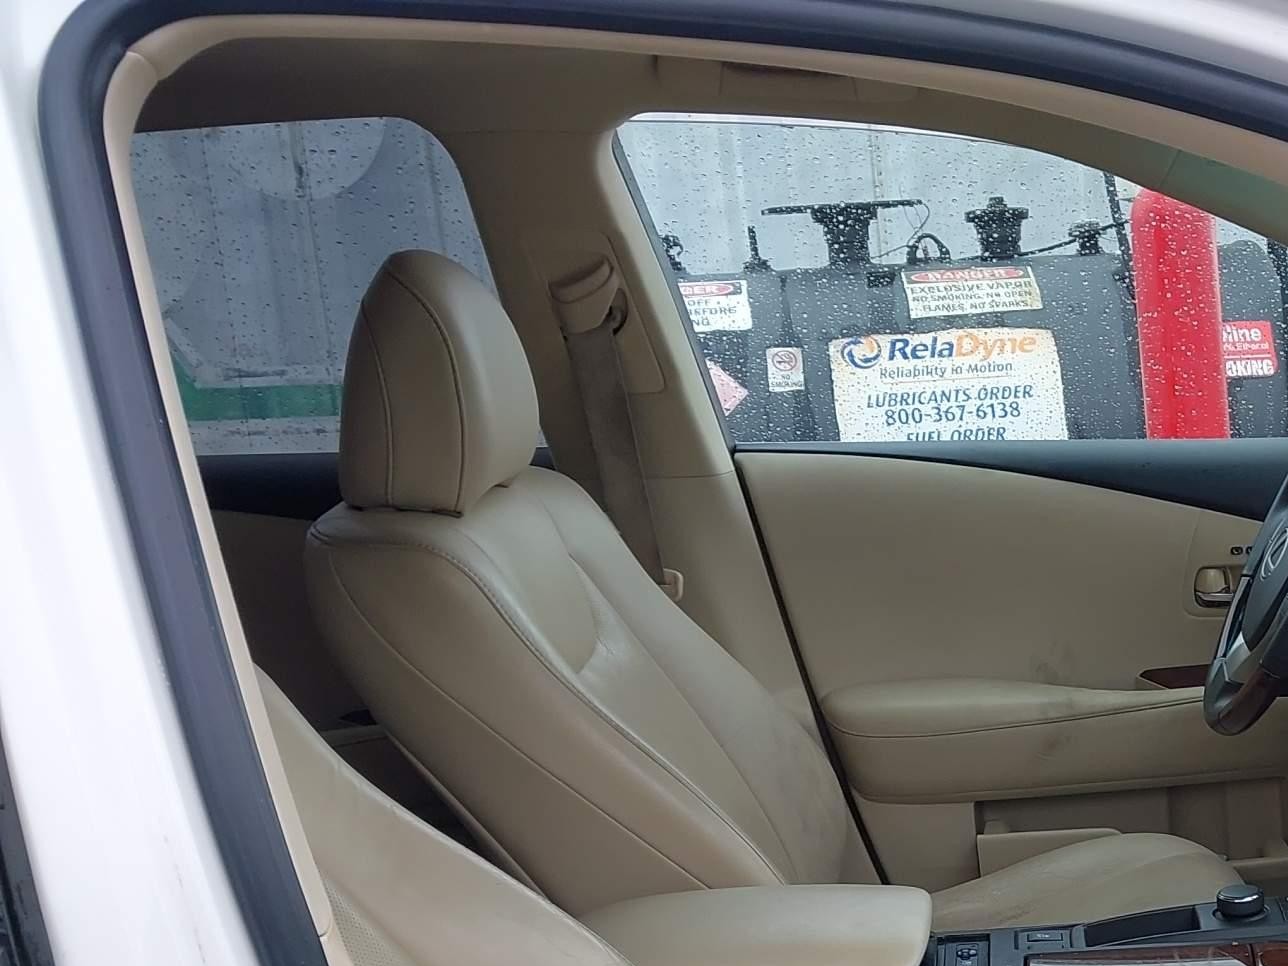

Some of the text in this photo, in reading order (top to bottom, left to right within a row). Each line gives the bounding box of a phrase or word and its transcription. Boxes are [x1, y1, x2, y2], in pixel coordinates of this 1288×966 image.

[910, 280, 984, 295] EXPLOSIVE
[1003, 289, 1033, 298] OPEN
[887, 332, 1037, 361] RelaDyne
[879, 360, 1013, 380] Reliability in Motion
[867, 384, 1034, 408] LUBRICANTS ORDER
[885, 400, 1021, 427] 800-367-6138
[950, 426, 1008, 441] ORDER
